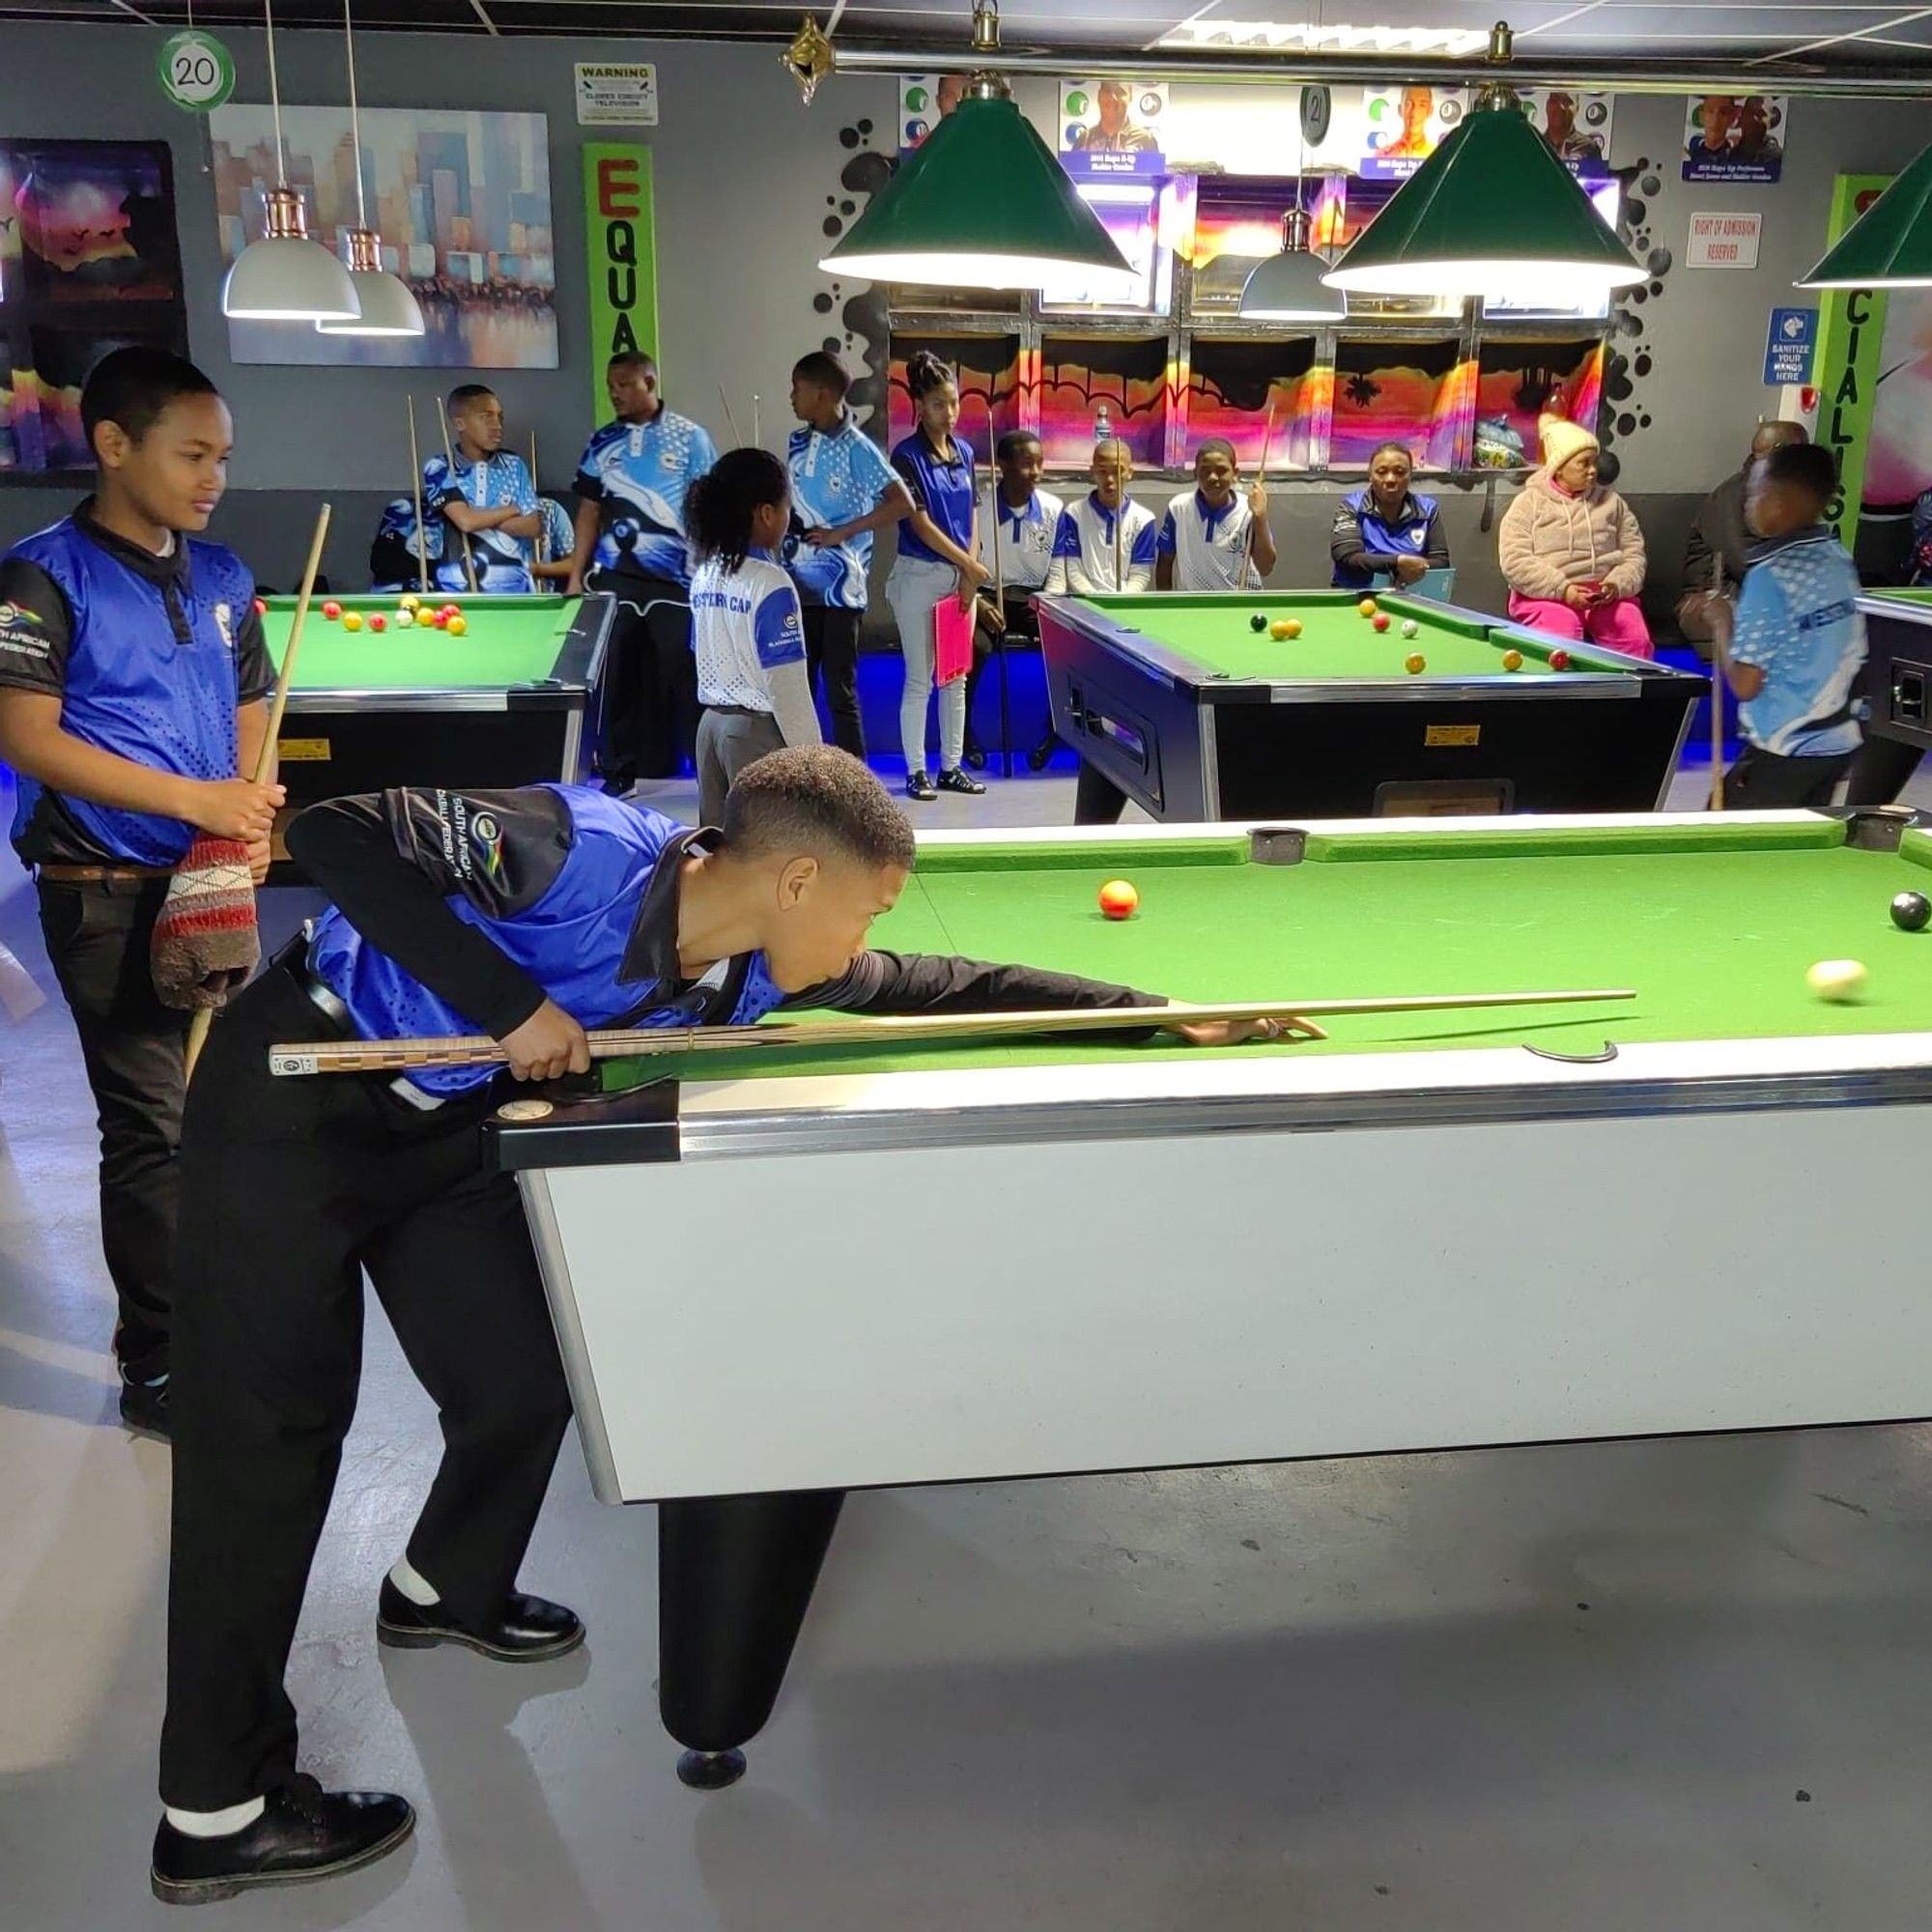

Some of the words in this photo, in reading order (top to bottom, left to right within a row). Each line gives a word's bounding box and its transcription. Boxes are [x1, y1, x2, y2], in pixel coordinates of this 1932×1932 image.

[176, 57, 215, 86] 20
[582, 68, 649, 78] WARNING
[1694, 219, 1714, 236] RIGHT
[1723, 219, 1757, 237] ADMISSION
[1707, 243, 1739, 261] RESERVED
[1772, 344, 1811, 355] SANITIZE
[1778, 354, 1802, 362] YOUR
[1776, 372, 1800, 382] HERE
[453, 797, 468, 835] SOUTH
